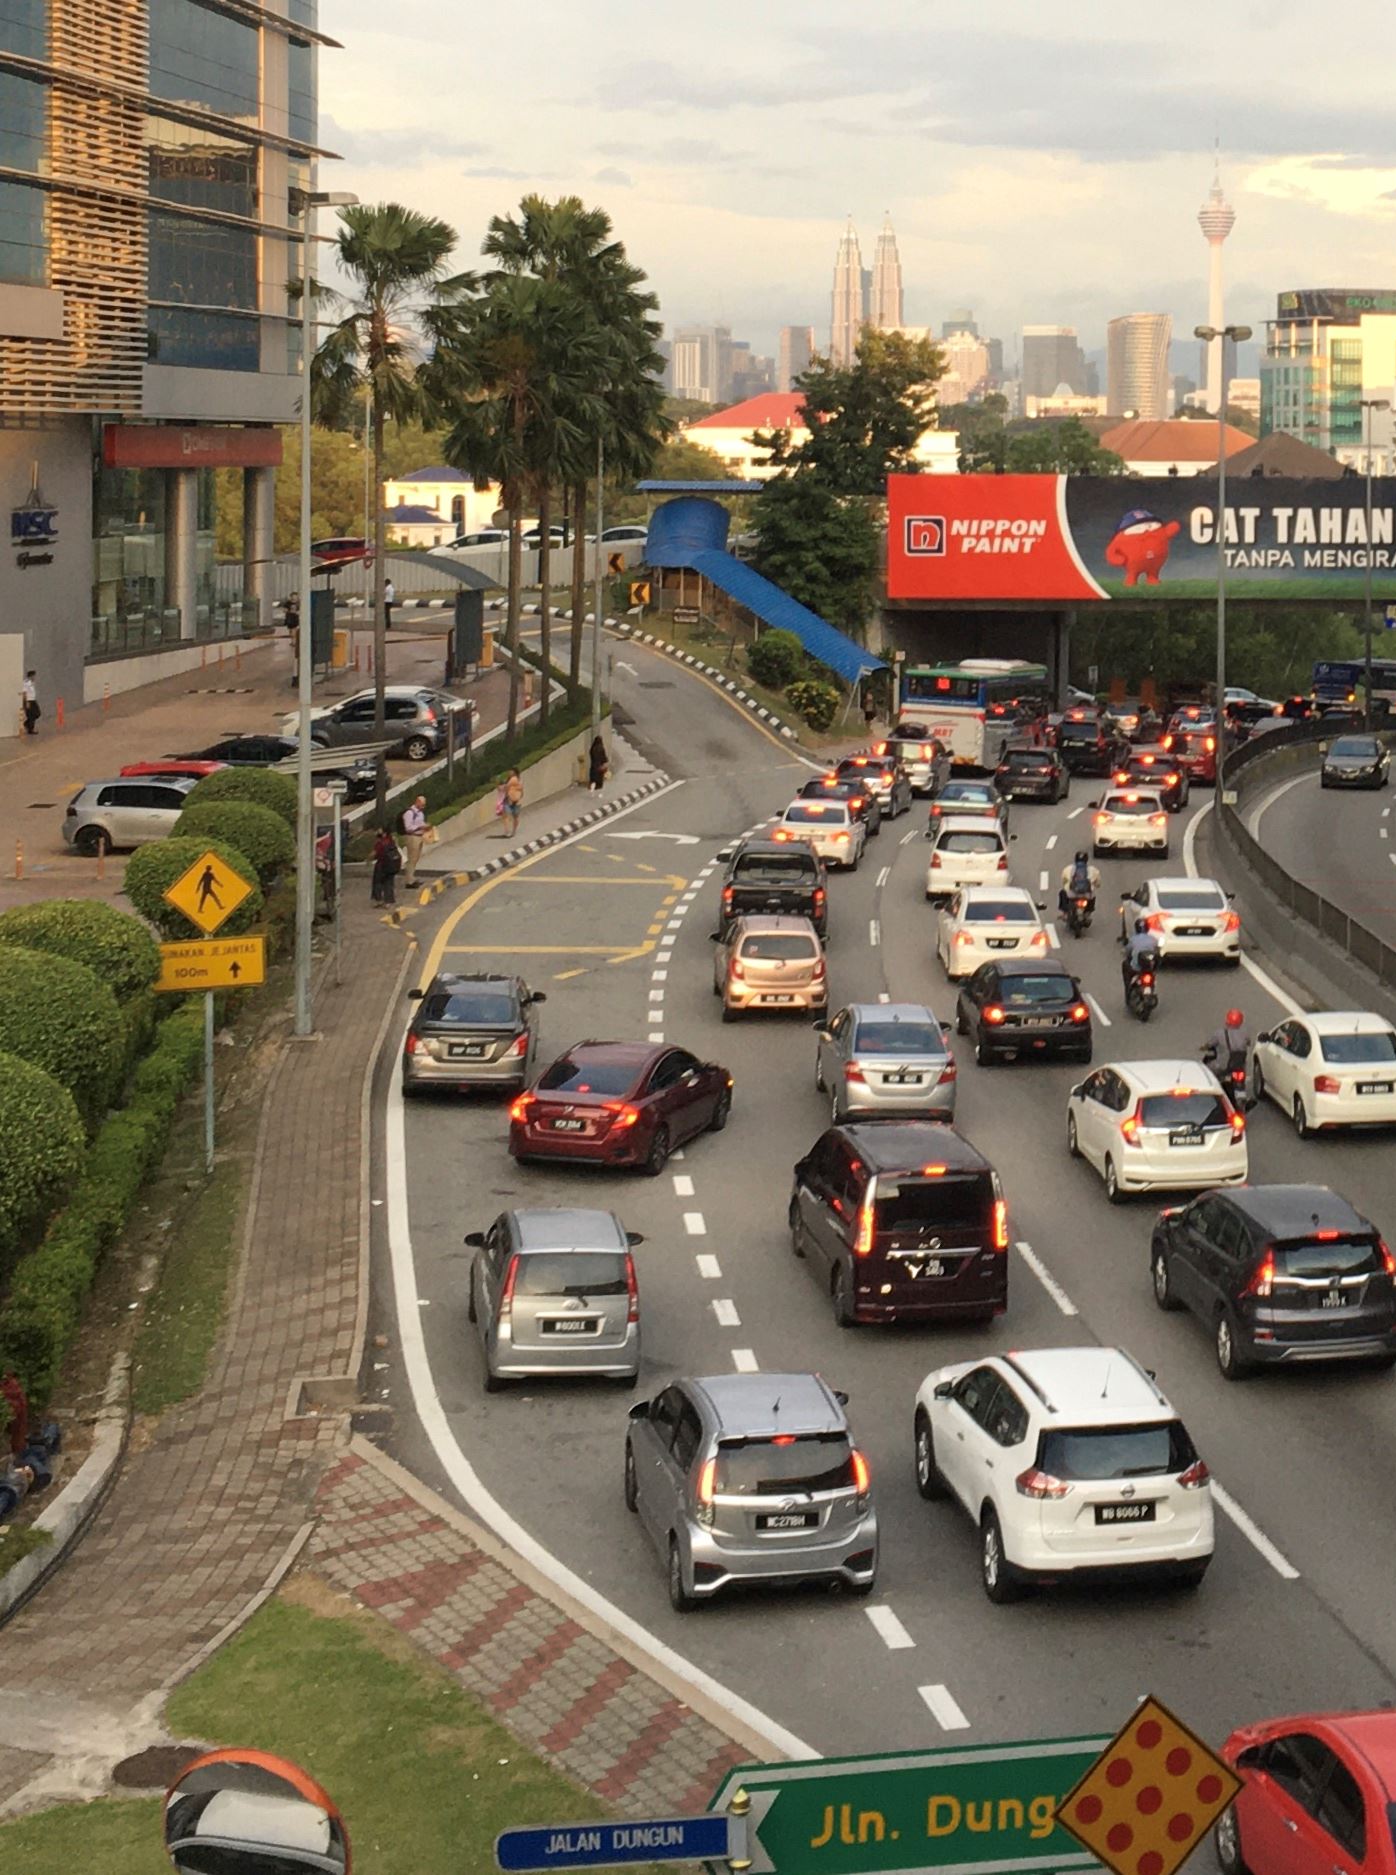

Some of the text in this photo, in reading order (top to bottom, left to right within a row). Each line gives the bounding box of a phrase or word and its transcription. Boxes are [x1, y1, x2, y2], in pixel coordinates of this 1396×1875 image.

[951, 519, 1047, 536] NIPPON
[1190, 506, 1261, 544] CAT
[1272, 507, 1393, 544] TAHAN
[961, 537, 1036, 553] PAINT
[1224, 549, 1295, 568] TANPA
[174, 967, 208, 978] 100m
[810, 1795, 1057, 1849] Jln. Dung
[545, 1825, 684, 1855] JALAN DUNGUN
